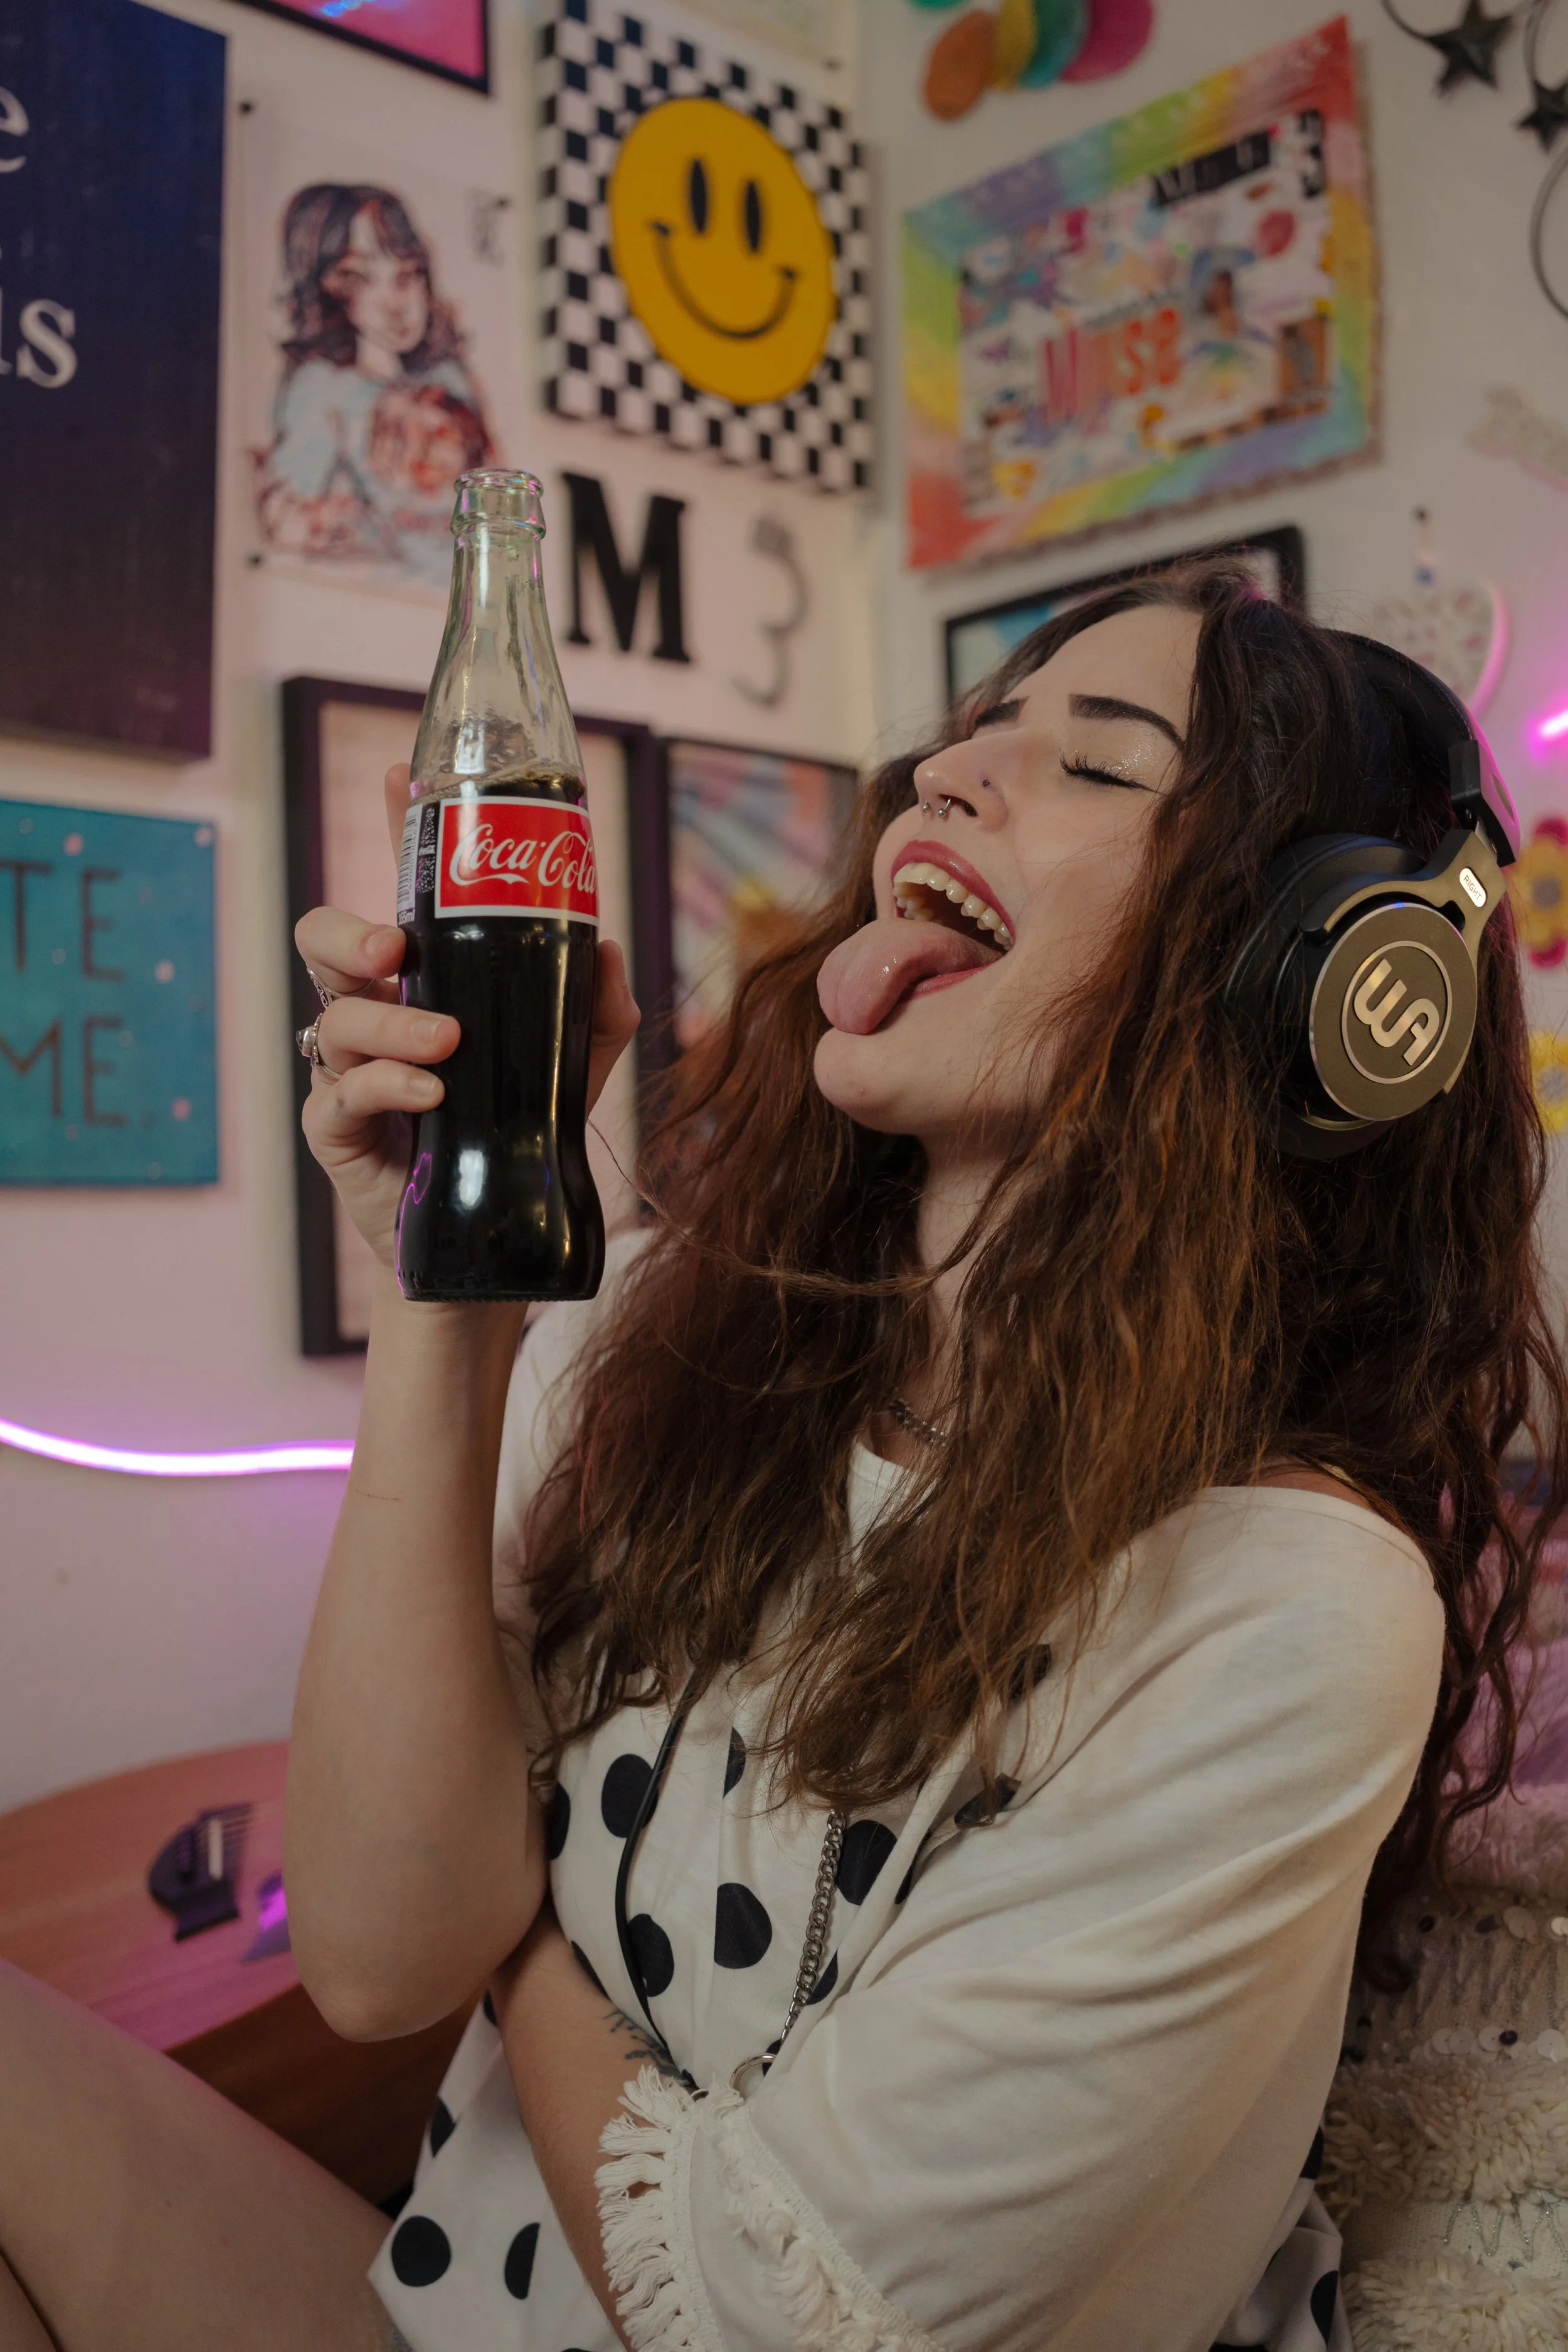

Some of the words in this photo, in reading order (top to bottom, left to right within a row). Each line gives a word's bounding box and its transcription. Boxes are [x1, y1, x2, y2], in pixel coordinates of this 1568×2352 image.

[562, 471, 692, 664] M
[450, 824, 596, 894] Coca-Cola
[1463, 875, 1482, 900] RIGHT
[398, 908, 415, 926] 355ml
